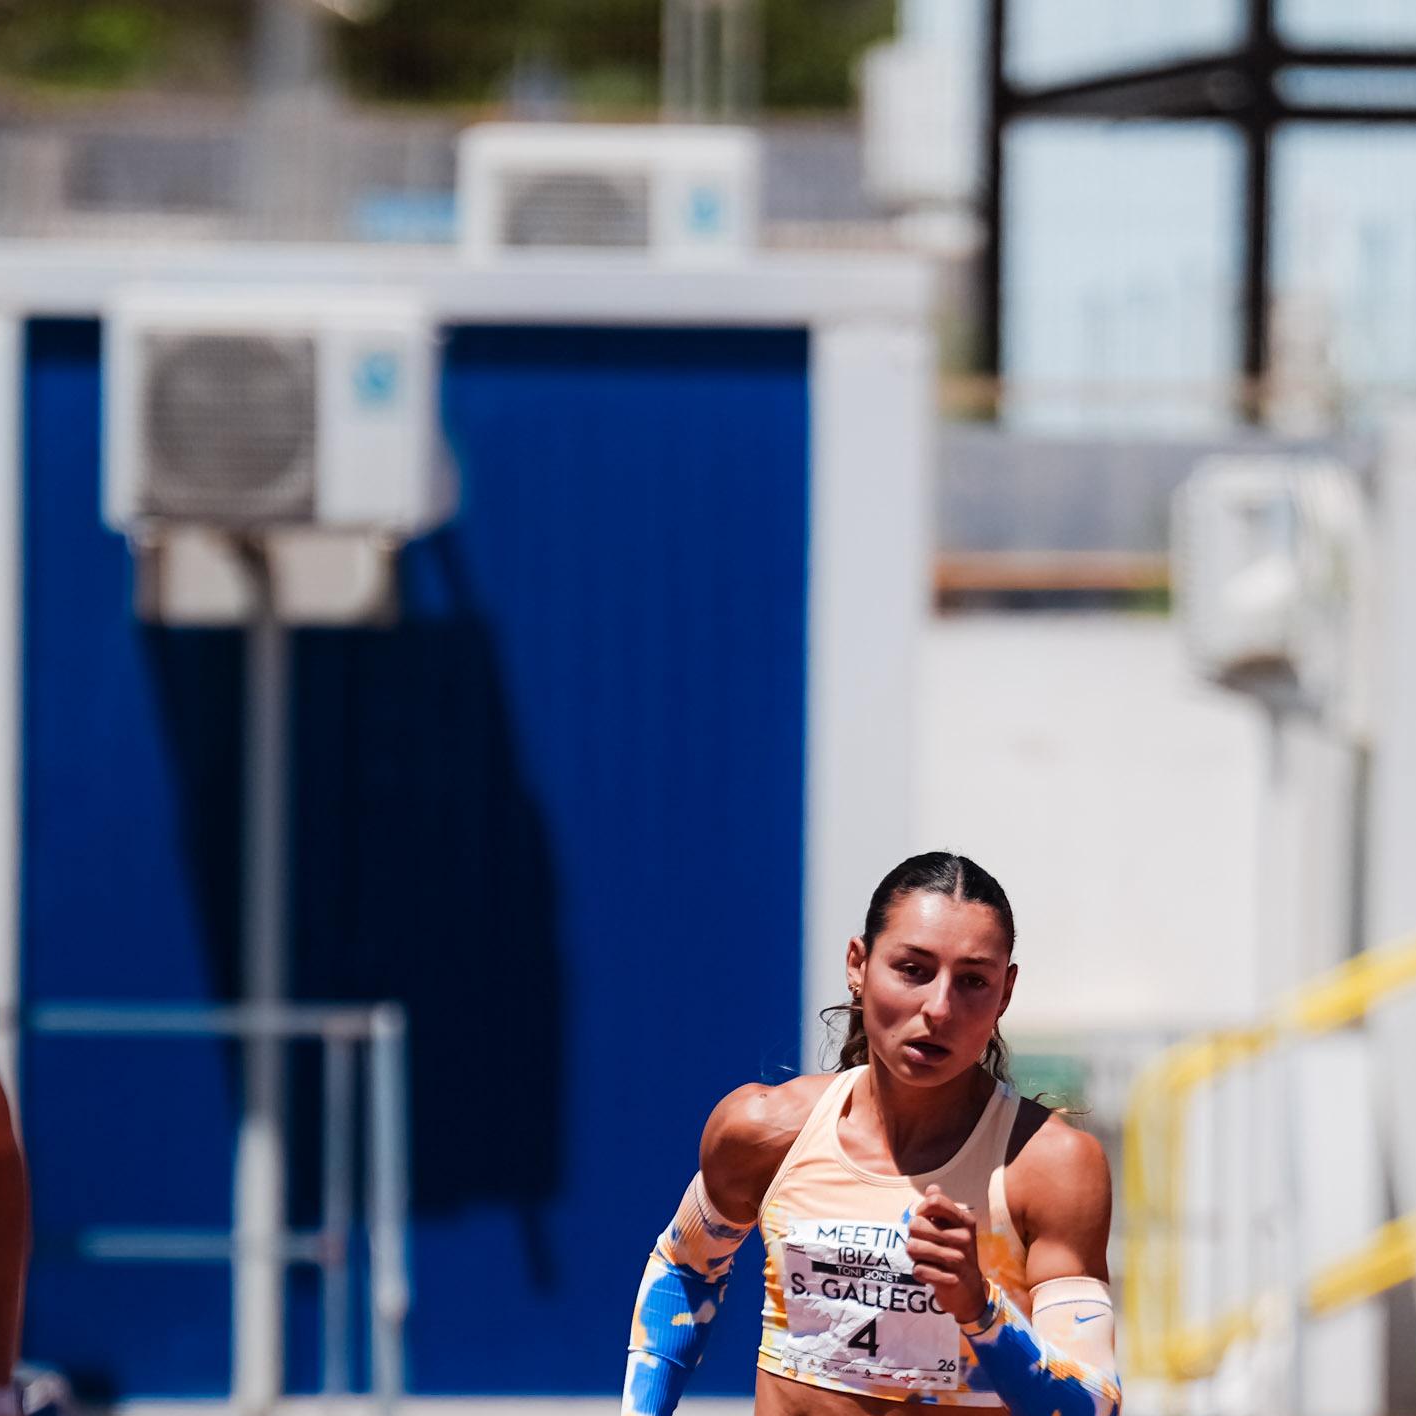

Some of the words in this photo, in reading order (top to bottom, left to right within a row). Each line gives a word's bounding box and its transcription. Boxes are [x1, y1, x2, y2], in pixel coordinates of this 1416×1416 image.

[816, 1225, 910, 1249] MEETIN
[837, 1246, 892, 1270] IBIZA
[836, 1265, 862, 1278] TONI
[791, 1272, 811, 1297] S.
[848, 1317, 880, 1358] 4
[937, 1359, 957, 1373] 26
